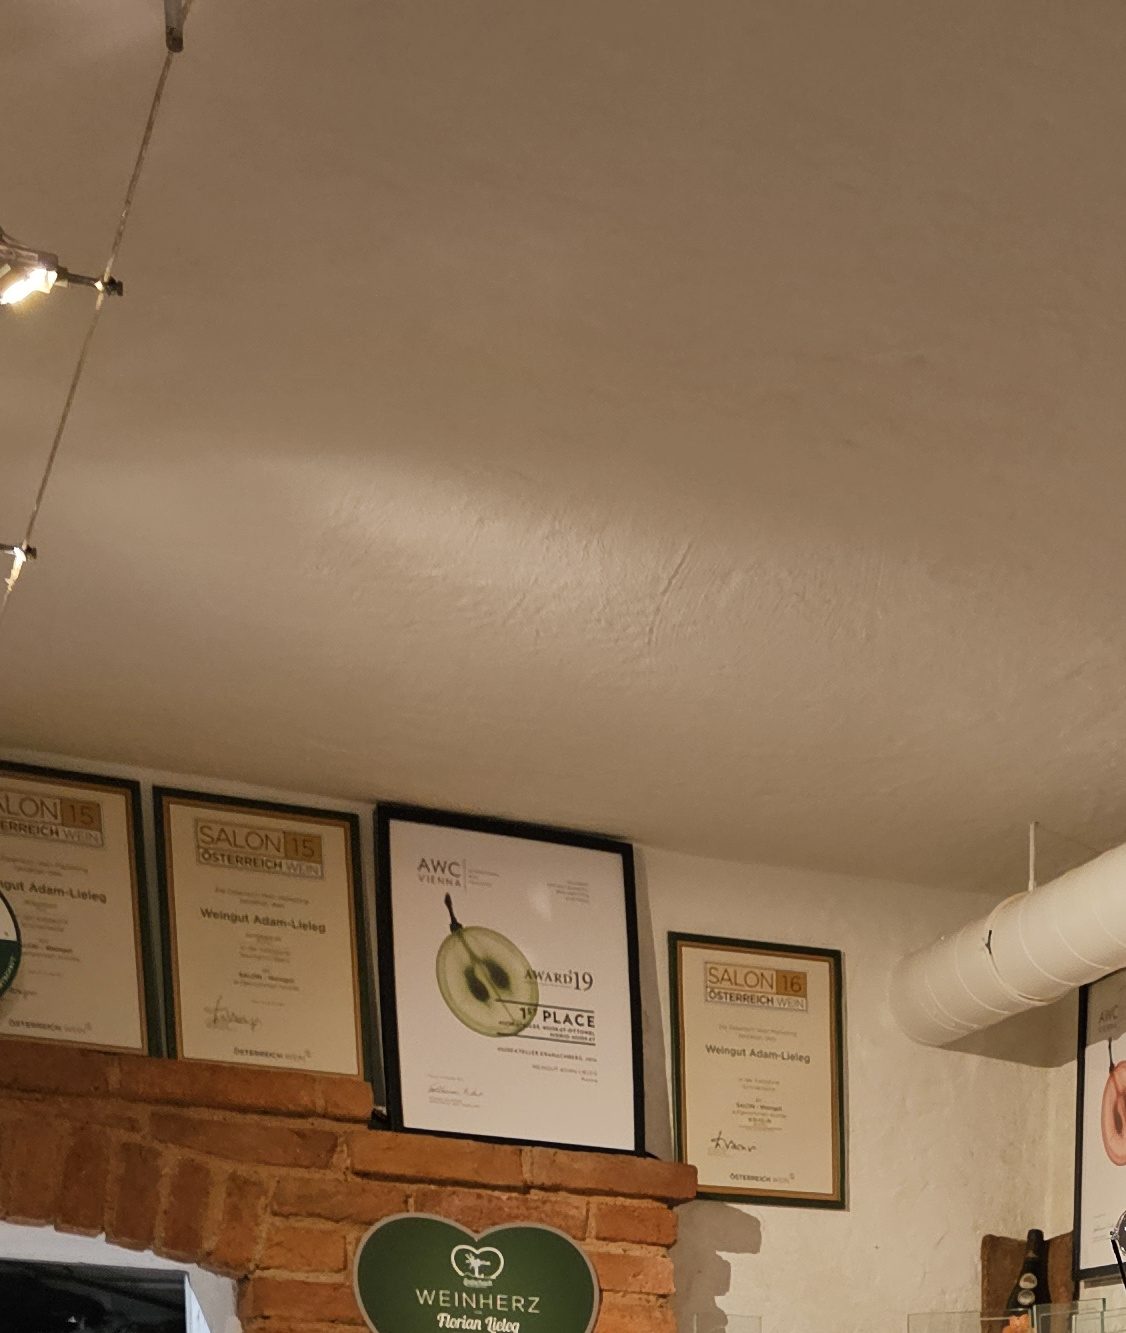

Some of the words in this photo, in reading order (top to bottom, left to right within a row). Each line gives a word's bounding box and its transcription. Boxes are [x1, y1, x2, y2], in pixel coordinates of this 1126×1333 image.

[70, 804, 95, 826] 15
[200, 824, 282, 854] SALON
[291, 837, 316, 858] 15
[201, 849, 283, 871] ÖSTERREICH
[285, 861, 320, 877] WEIN
[417, 857, 462, 878] AWC
[417, 873, 462, 888] VIENNA
[200, 906, 250, 925] Weingut
[253, 914, 327, 935] Adam-Lieleg
[708, 965, 775, 992] SALON
[782, 974, 803, 993] 16
[707, 989, 775, 1007] ÖSTERREICH
[776, 996, 805, 1009] WEIN
[542, 1009, 596, 1029] PLACE
[704, 1043, 747, 1058] Weingut
[749, 1047, 811, 1065] Adam-Lieleg
[414, 1287, 541, 1315] WEINHERZ
[435, 1311, 483, 1332] Florian
